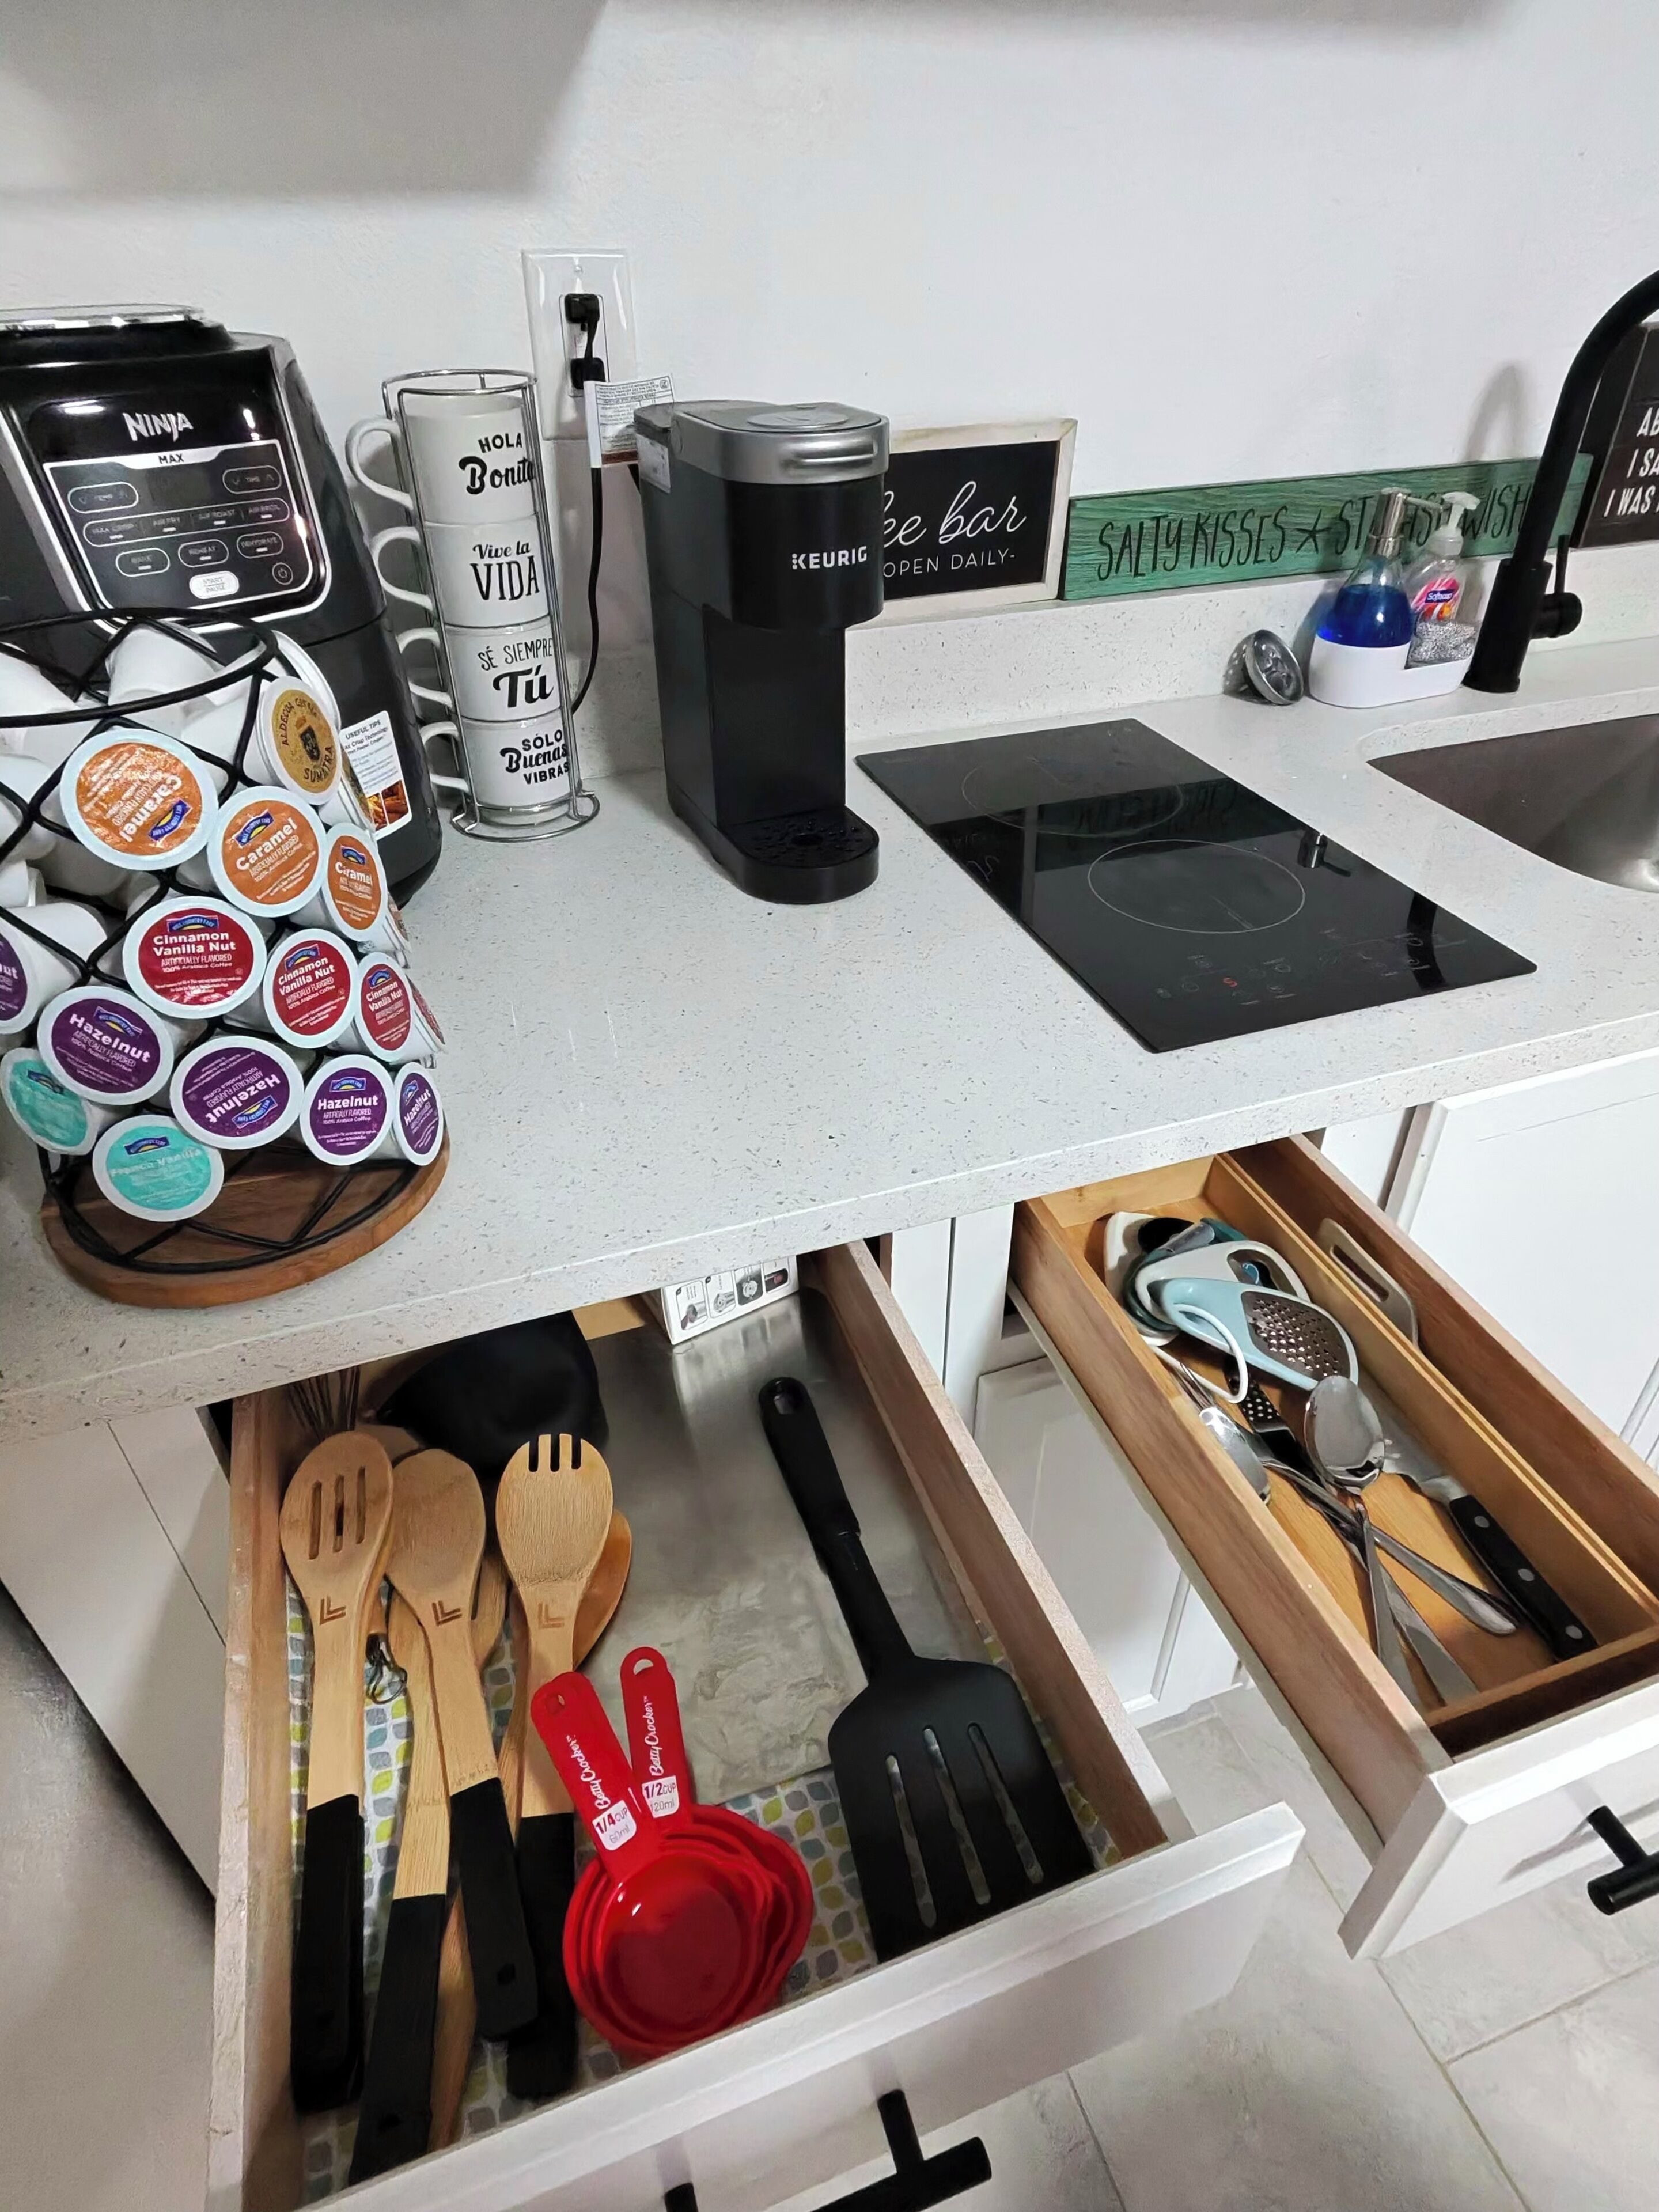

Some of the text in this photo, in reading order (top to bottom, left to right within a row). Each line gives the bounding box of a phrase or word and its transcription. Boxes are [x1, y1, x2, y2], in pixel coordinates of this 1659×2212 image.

[123, 412, 194, 442] NINJA
[478, 433, 522, 454] HOLA
[158, 454, 184, 465] MAX
[938, 480, 1027, 545] bar
[1617, 485, 1656, 516] WAS
[472, 540, 531, 559] Vive la
[1190, 505, 1288, 569] KISSES
[791, 546, 867, 570] KEURIG
[469, 555, 540, 601] VIDA
[477, 638, 553, 671] SÉ SIEMPRE
[493, 664, 554, 708] Tú
[345, 719, 381, 740] USEFUL TIPS
[499, 743, 568, 774] Buenas
[523, 761, 570, 785] VIBRAS
[119, 774, 183, 843] Caramel
[236, 817, 298, 871] Caramel
[335, 861, 373, 887] Caramel
[153, 932, 229, 946] Cinnamon
[153, 941, 237, 956] Vanilla Nut
[201, 953, 232, 963] FLAVORED
[278, 957, 329, 986] Cinnamon
[279, 964, 335, 996] Vanilla Nut
[365, 980, 399, 1002] Cinnamon
[368, 988, 403, 1012] Vanilla Nut
[69, 1013, 151, 1063] Hazelnut
[205, 1074, 281, 1123] Hazelnut
[317, 1094, 378, 1111] Hazelnut
[403, 1088, 431, 1126] Hazelnut
[663, 1782, 677, 1793] CUP
[616, 1806, 628, 1822] CUP
